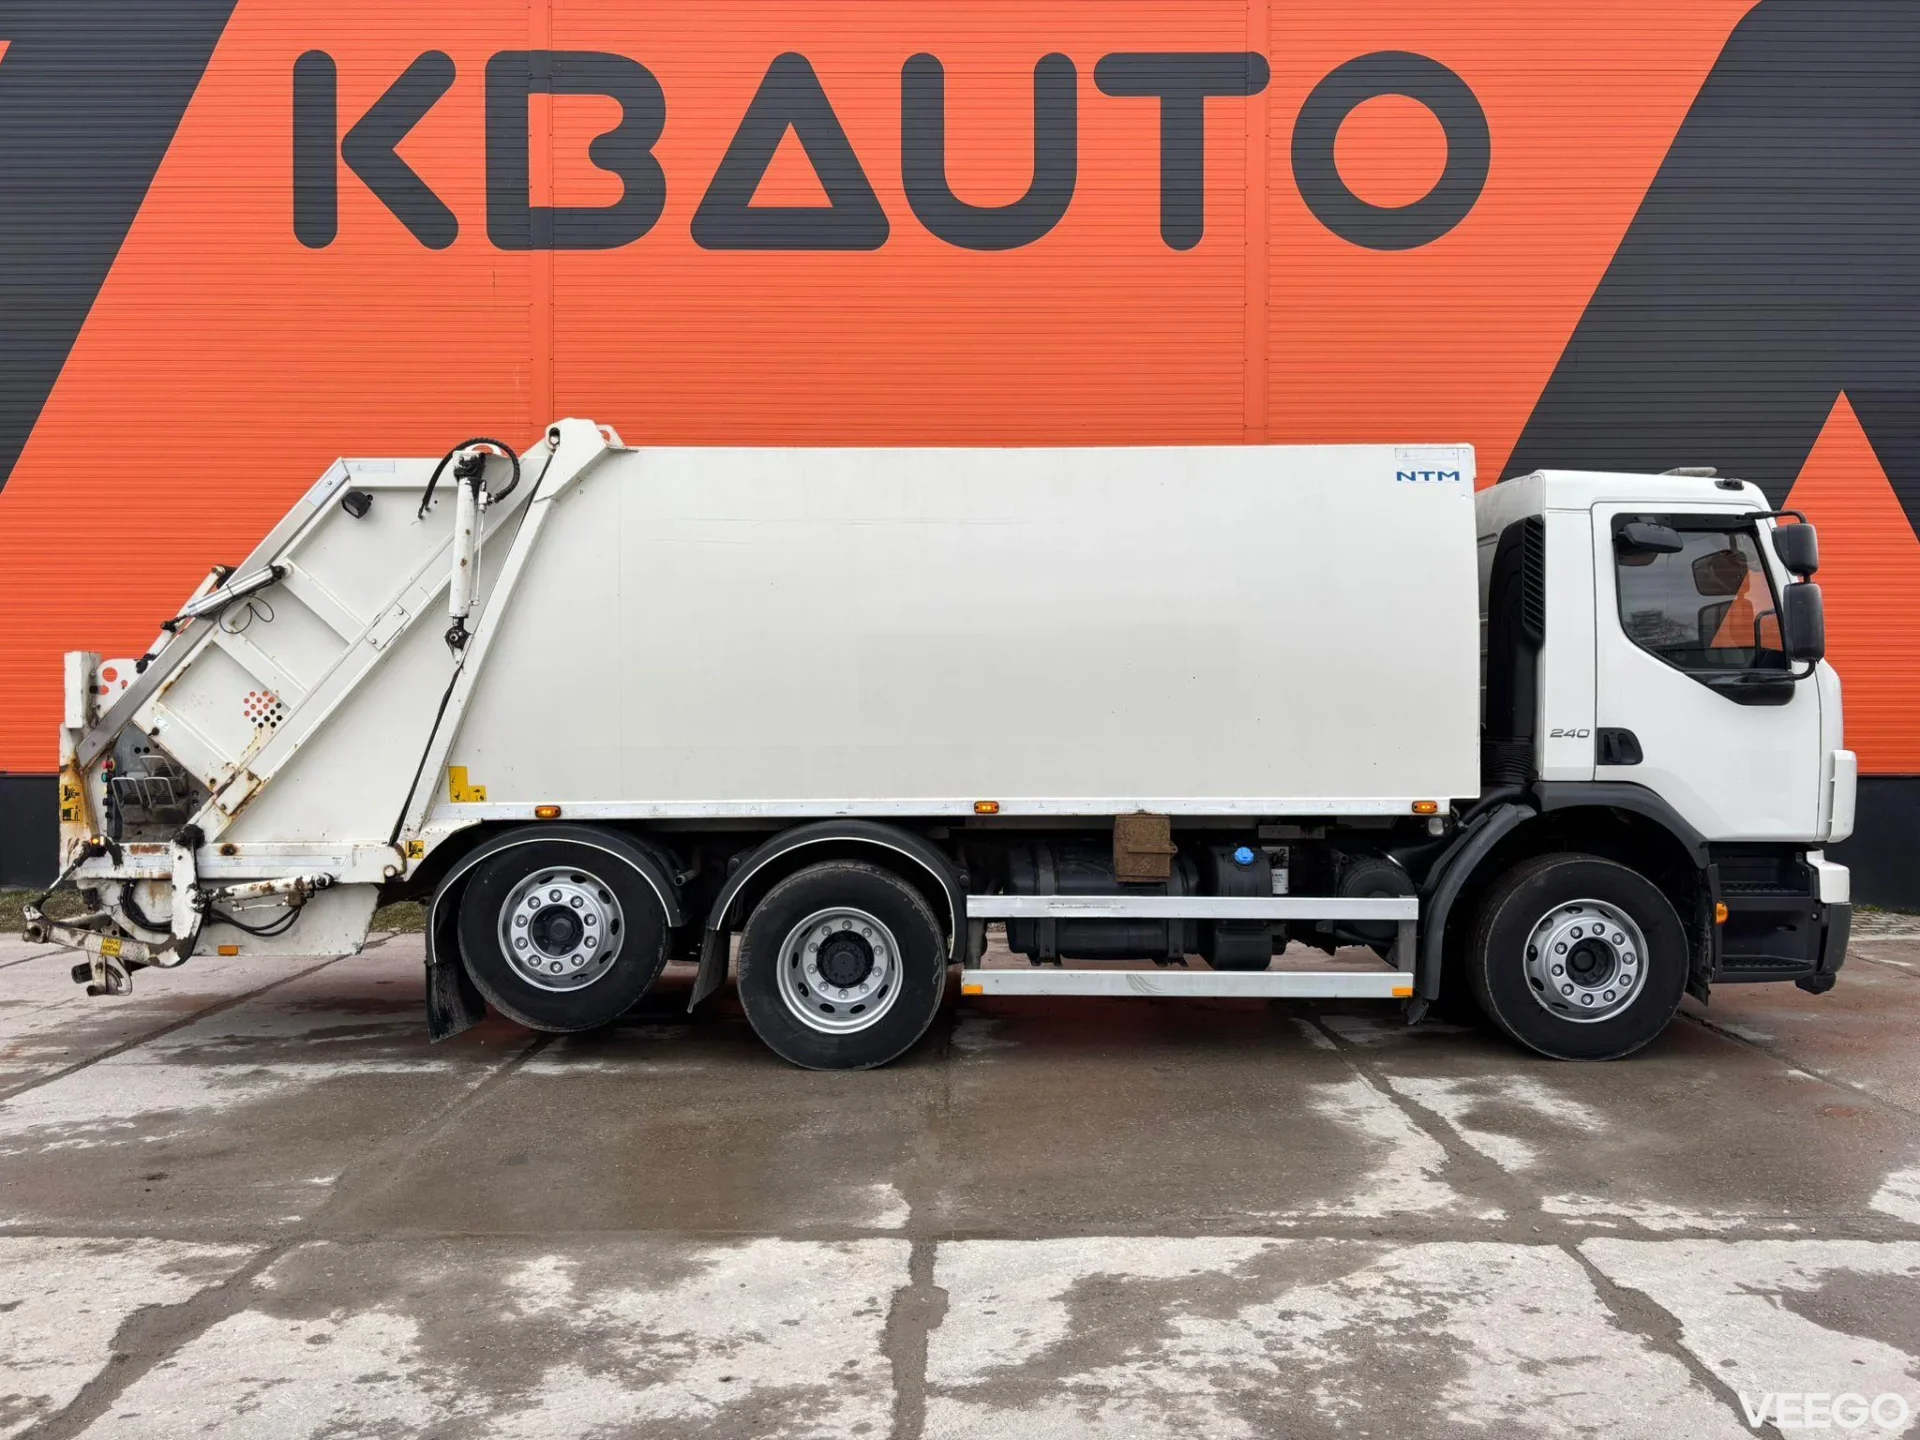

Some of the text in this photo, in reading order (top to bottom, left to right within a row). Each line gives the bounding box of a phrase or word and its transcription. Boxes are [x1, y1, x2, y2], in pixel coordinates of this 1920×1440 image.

[293, 49, 1491, 251] KBAUTO
[1396, 471, 1460, 481] NTM
[1550, 728, 1590, 738] 240
